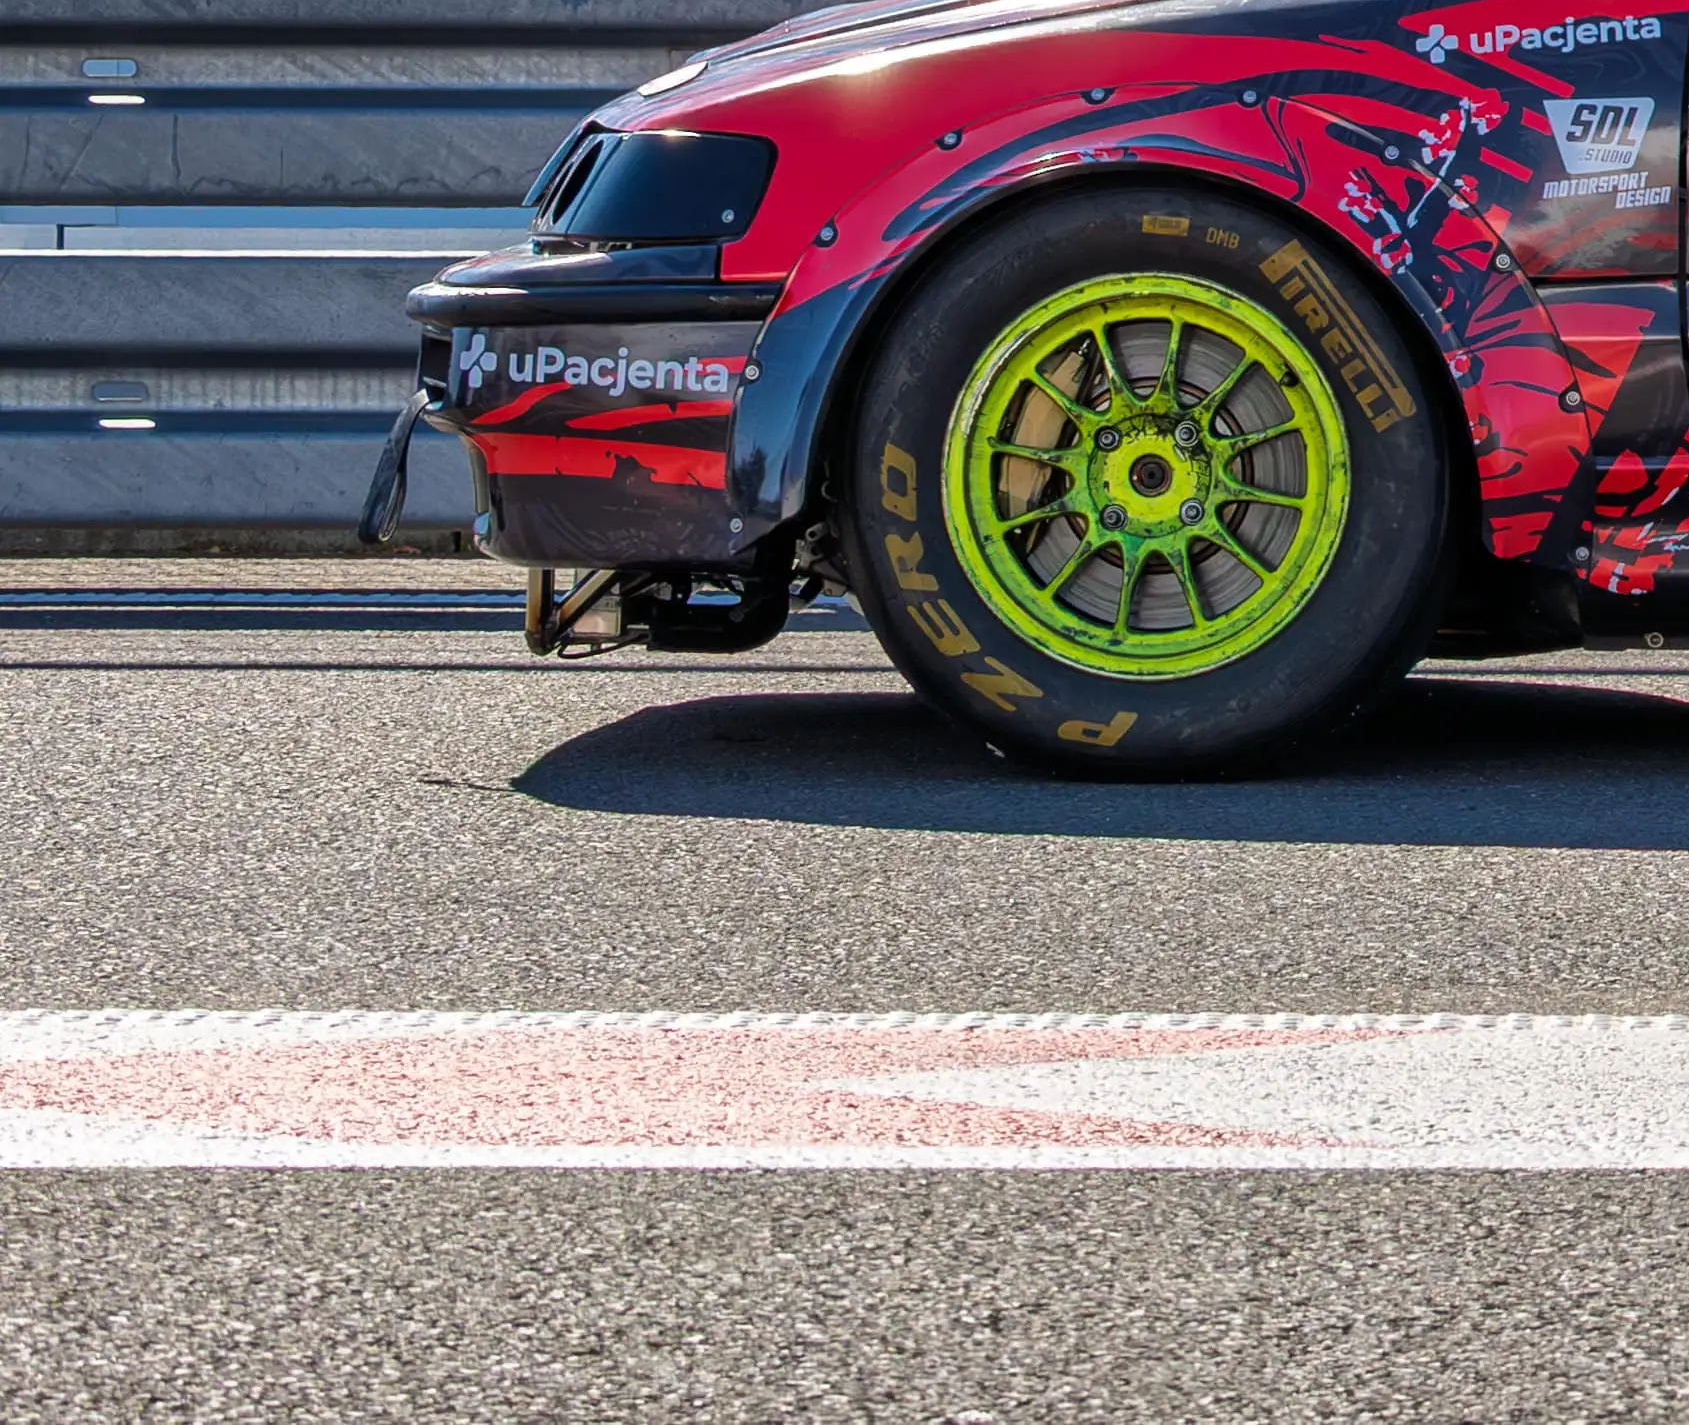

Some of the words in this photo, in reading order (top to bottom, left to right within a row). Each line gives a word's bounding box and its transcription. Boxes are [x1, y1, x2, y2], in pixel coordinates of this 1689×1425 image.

[1469, 16, 1662, 53] uPacjenta
[1566, 103, 1639, 147] SDL
[1542, 171, 1649, 200] MOTORSPORT
[1615, 186, 1672, 210] DESIGN
[1258, 238, 1418, 434] PIRELLI
[508, 346, 729, 397] uPacjenta
[880, 443, 1044, 712] ZERO
[1058, 711, 1139, 747] P
